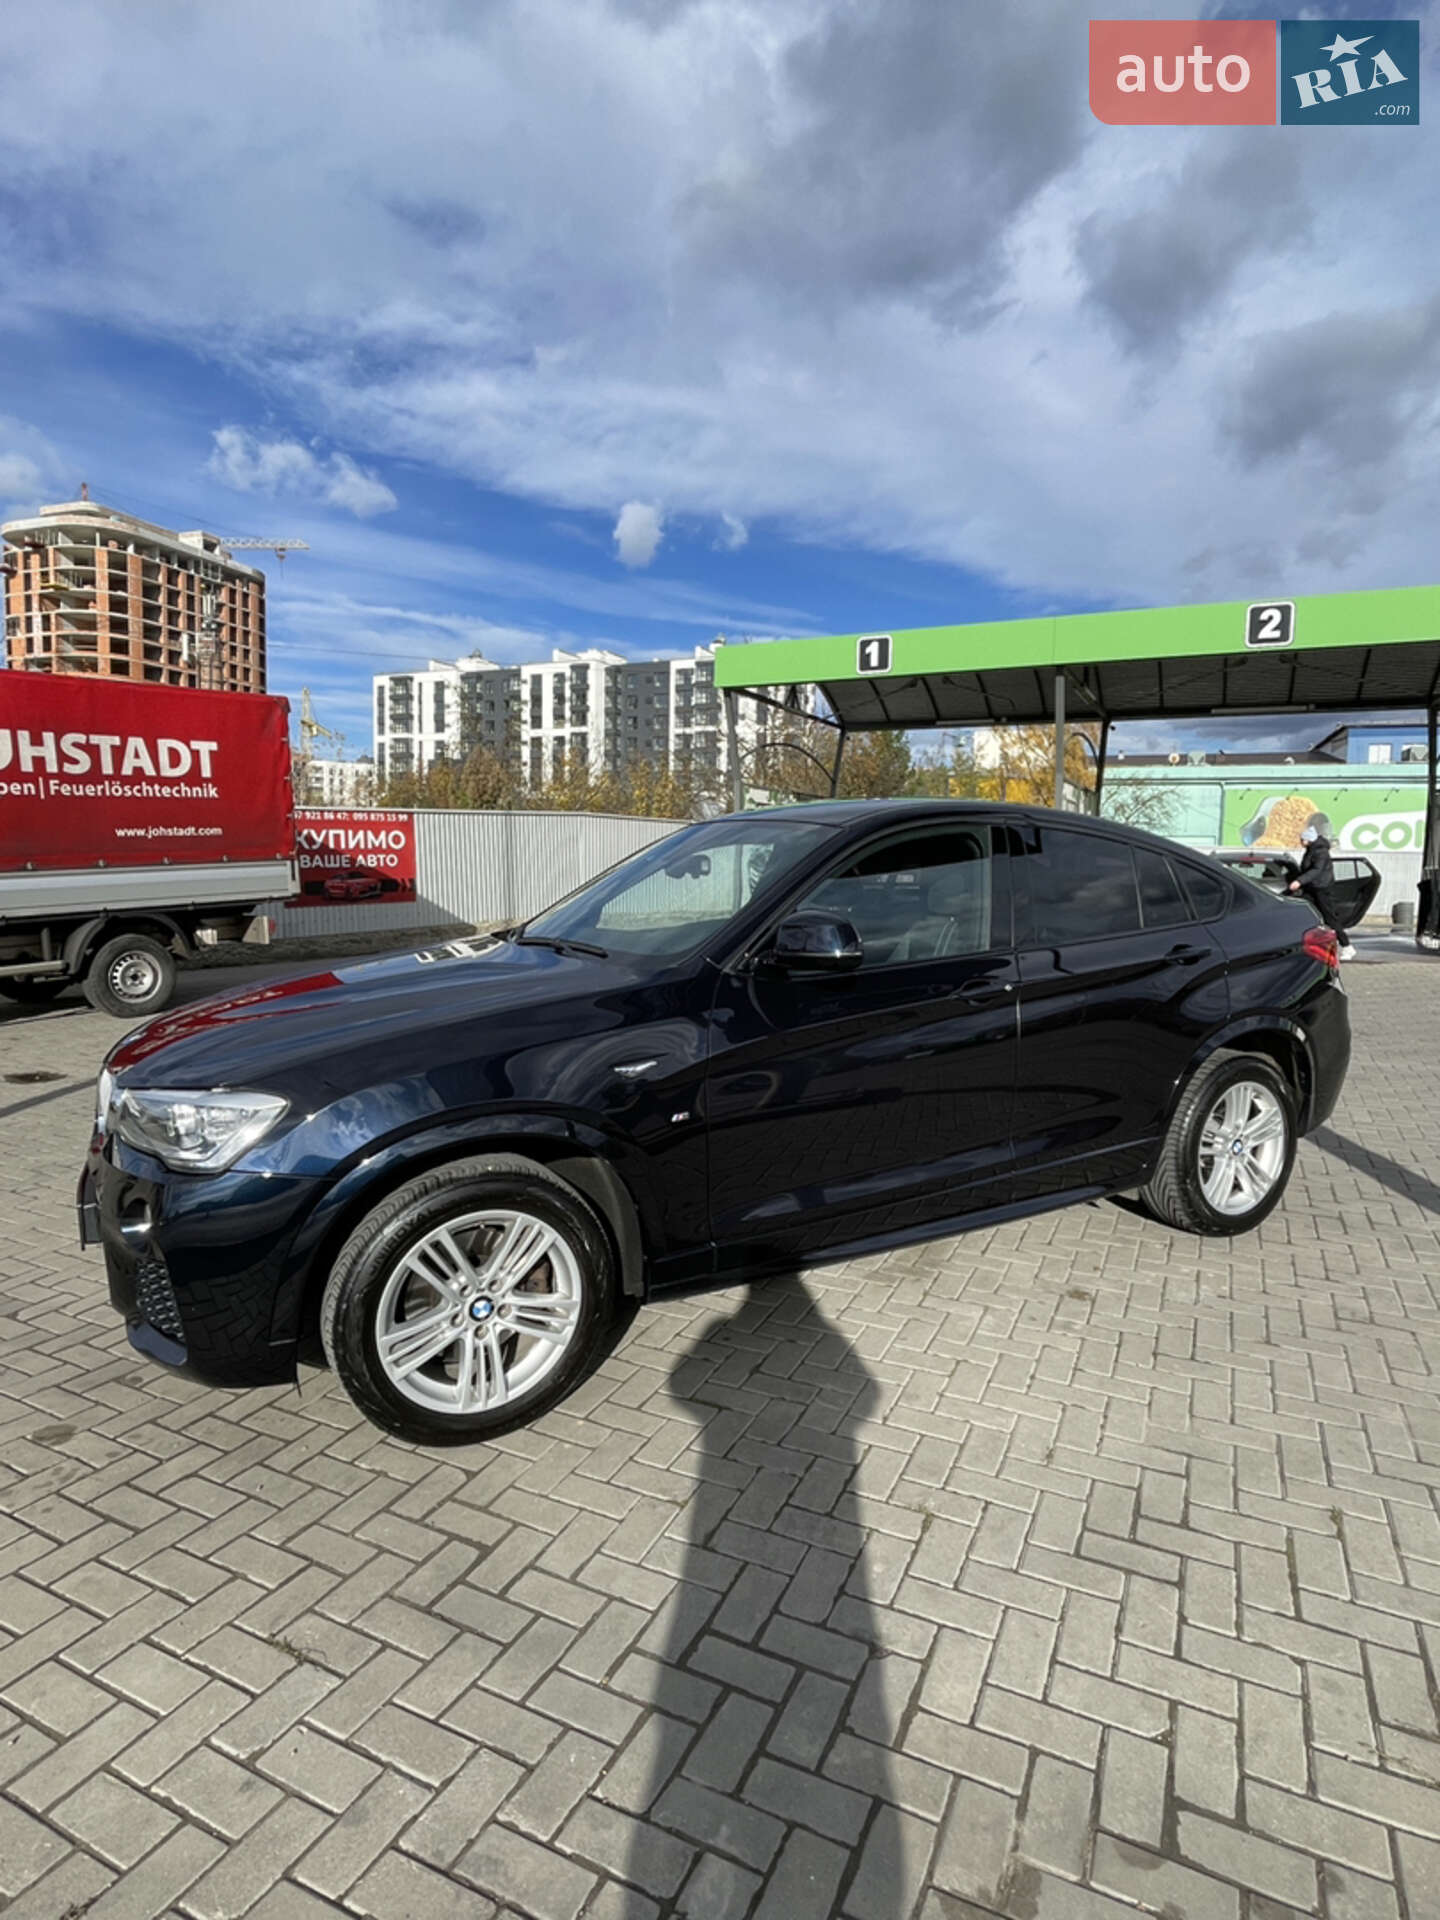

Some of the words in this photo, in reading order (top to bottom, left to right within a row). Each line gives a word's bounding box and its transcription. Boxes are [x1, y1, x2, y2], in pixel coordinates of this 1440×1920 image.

[1257, 608, 1282, 640] 2
[864, 641, 880, 668] 1
[50, 779, 219, 799] Feuerlöschtechnik
[115, 825, 222, 839] www.johstadt.com
[300, 854, 351, 869] ВАШЕ
[355, 854, 399, 868] АВТО
